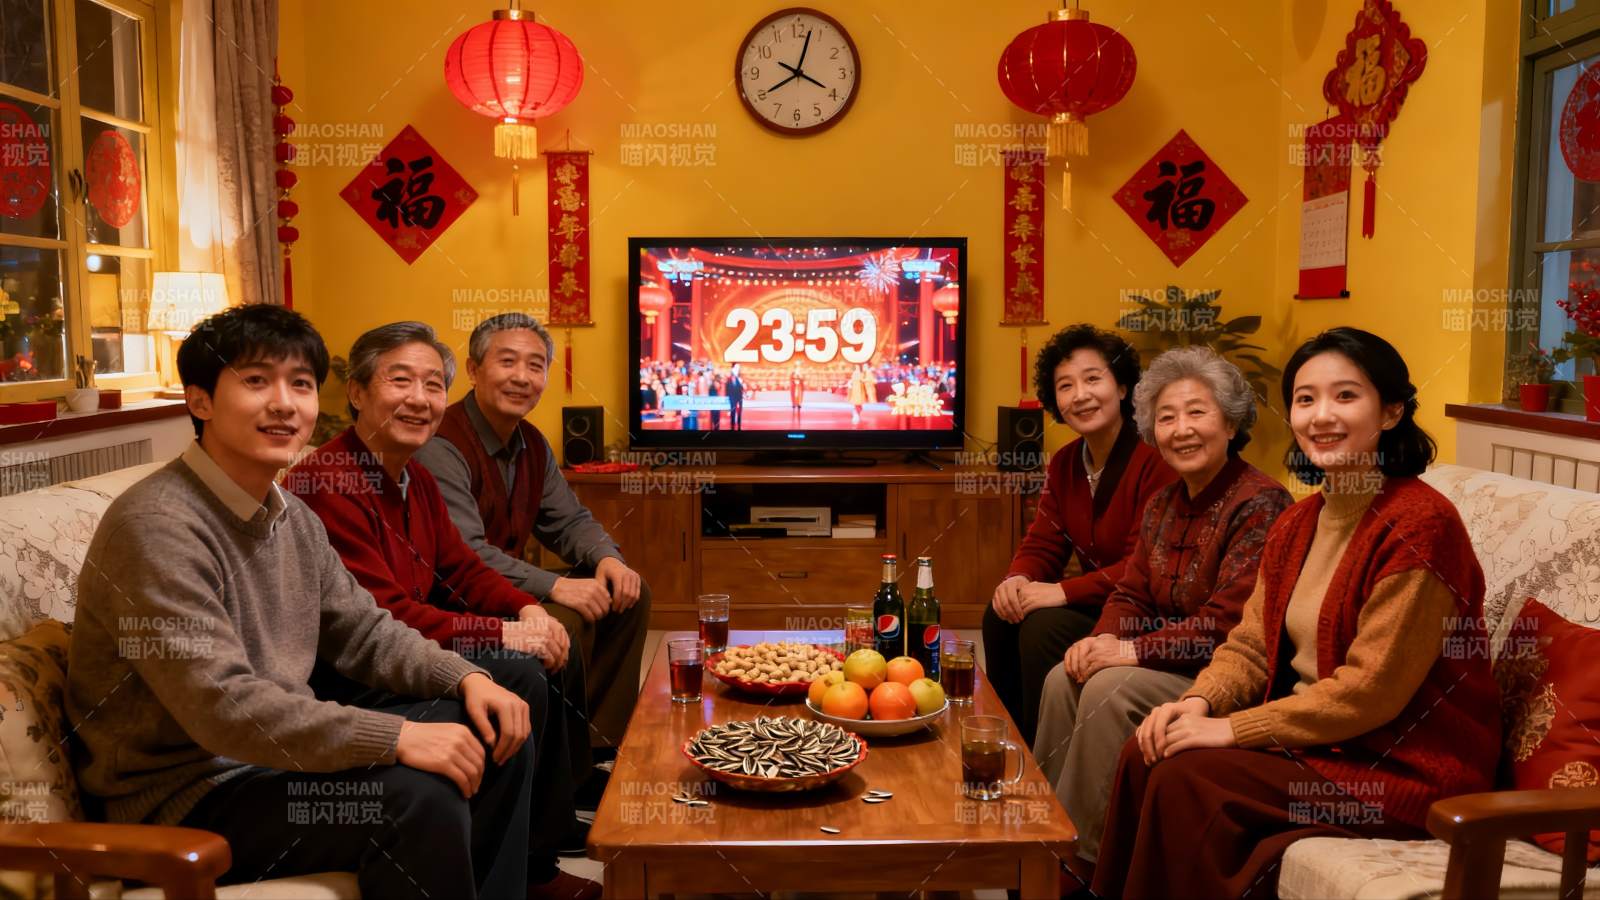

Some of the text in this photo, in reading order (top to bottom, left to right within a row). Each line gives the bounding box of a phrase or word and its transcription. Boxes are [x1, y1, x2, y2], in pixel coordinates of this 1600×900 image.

[791, 23, 806, 38] 12
[758, 45, 772, 60] 10
[830, 47, 840, 60] 2
[750, 66, 760, 80] 9
[838, 67, 846, 80] 3
[1344, 33, 1387, 107] 福
[828, 88, 838, 101] 4
[773, 103, 782, 118] 7
[793, 108, 801, 122] 6
[813, 103, 822, 117] 5
[370, 156, 446, 231] 福
[1143, 160, 1217, 232] 福
[723, 307, 877, 364] 23:59
